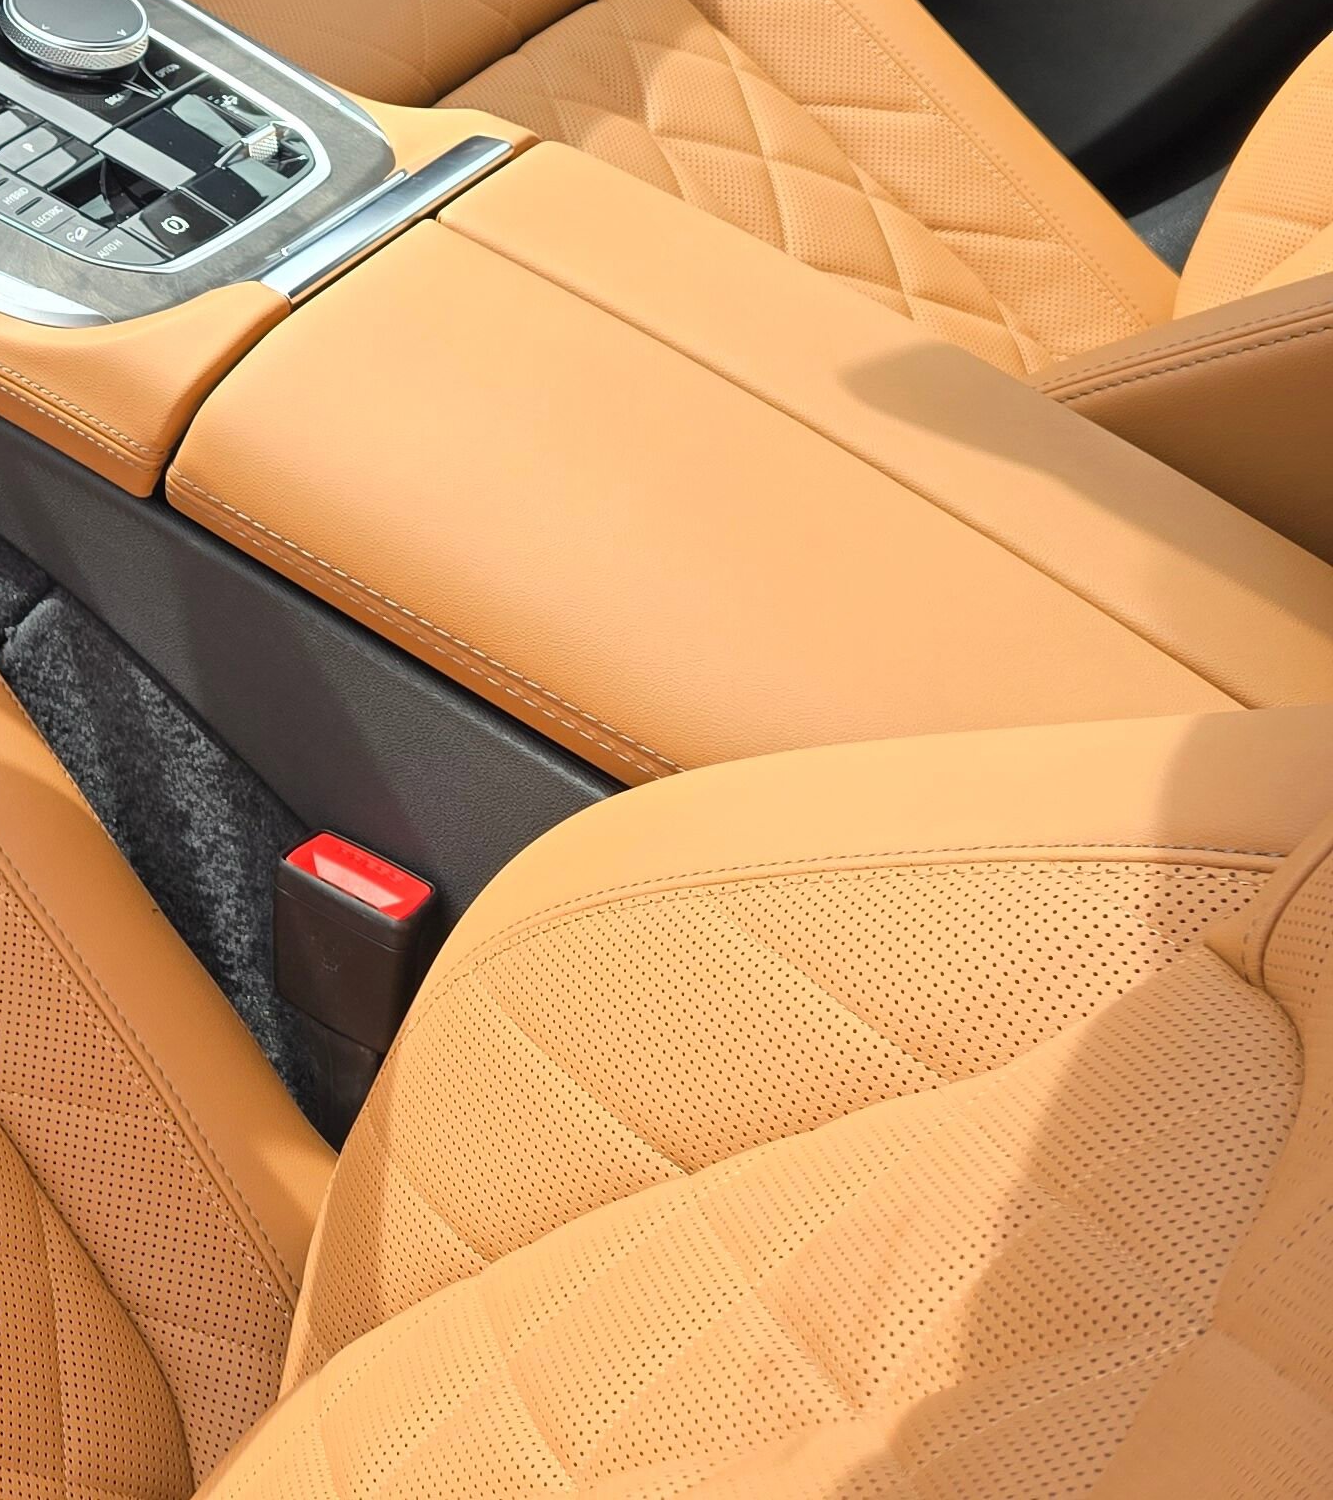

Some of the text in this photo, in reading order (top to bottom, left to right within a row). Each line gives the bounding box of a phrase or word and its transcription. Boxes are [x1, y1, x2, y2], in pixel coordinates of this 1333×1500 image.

[2, 187, 30, 206] HYBRID
[32, 205, 65, 228] ELECTRIC
[97, 242, 117, 259] AUTO
